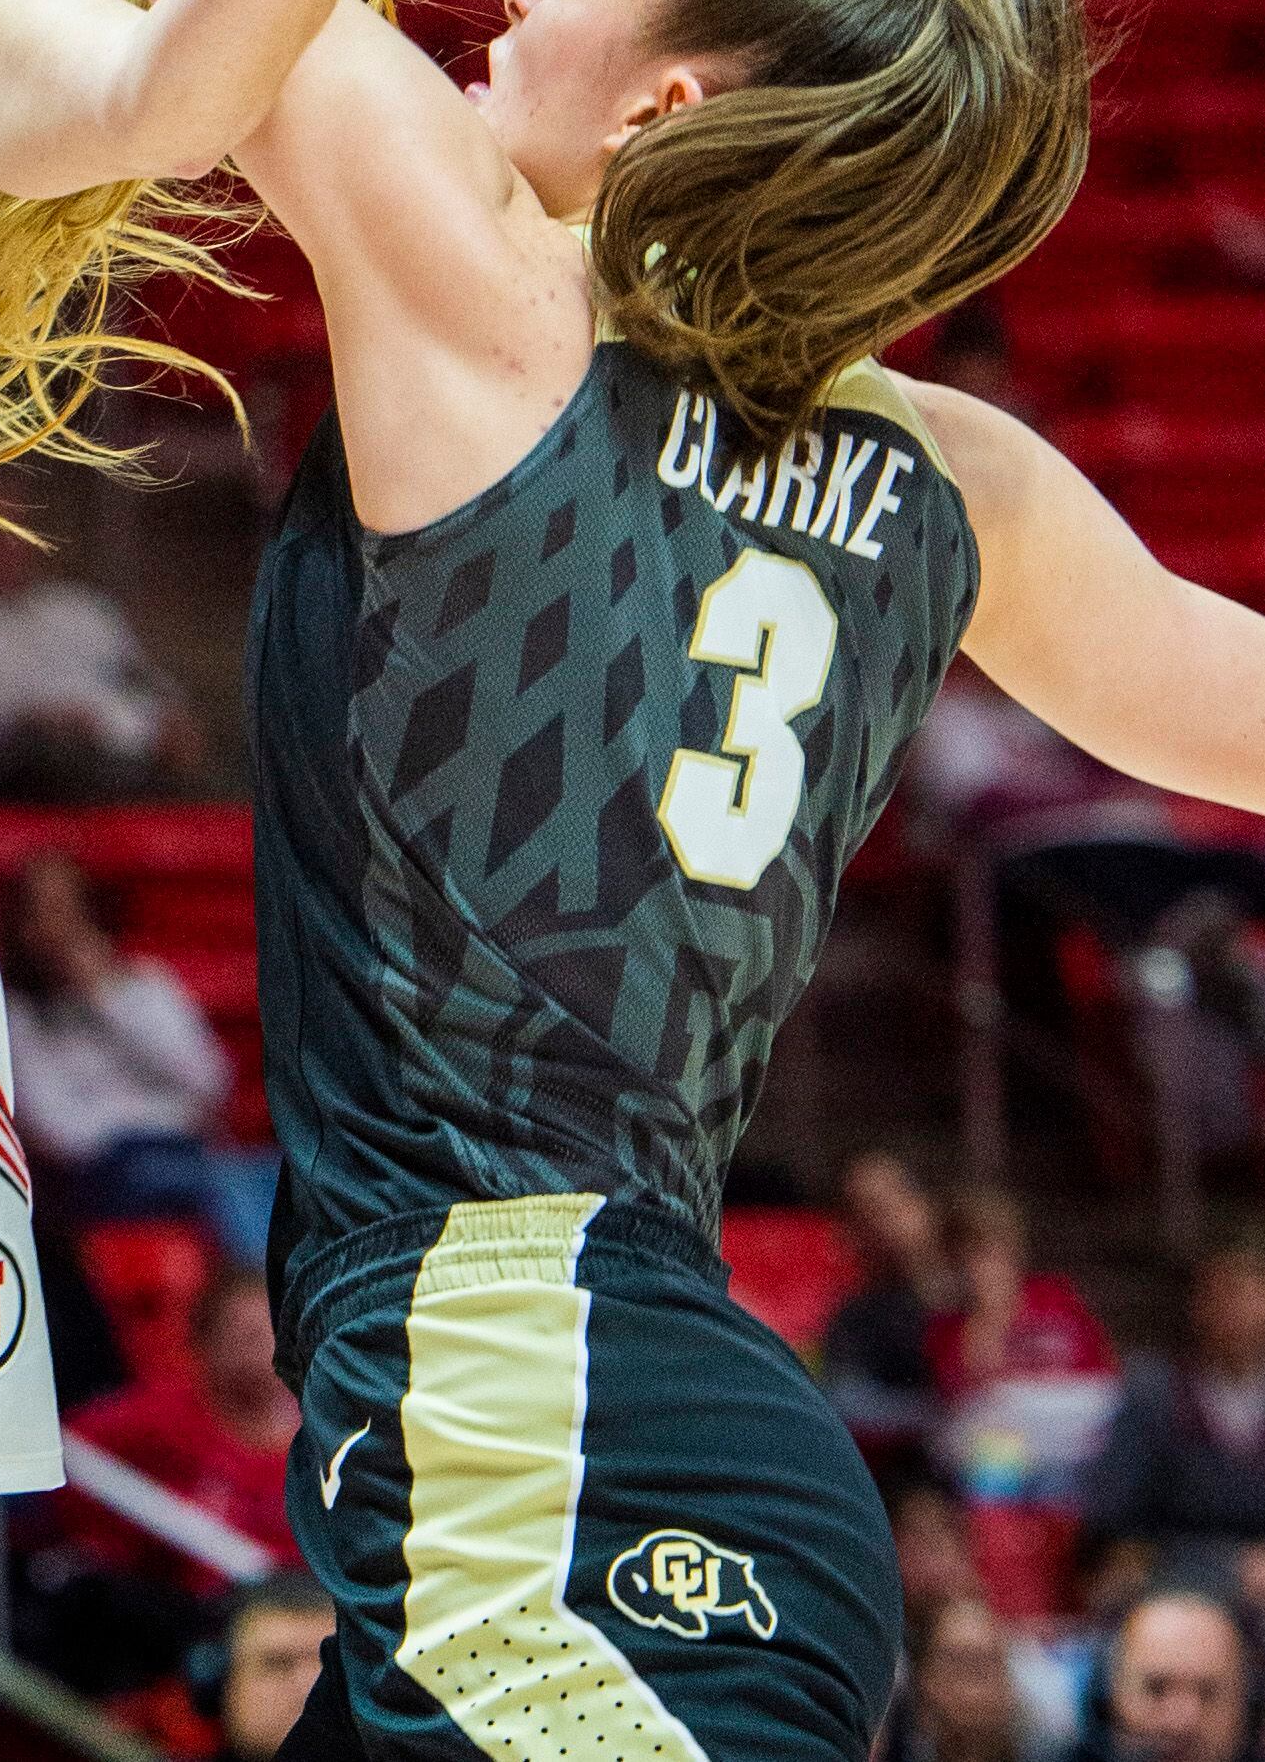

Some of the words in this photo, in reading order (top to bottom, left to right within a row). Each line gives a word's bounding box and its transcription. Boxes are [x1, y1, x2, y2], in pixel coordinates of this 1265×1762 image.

[657, 388, 916, 561] CLARKE
[658, 547, 839, 892] 3
[652, 1541, 722, 1613] CU
